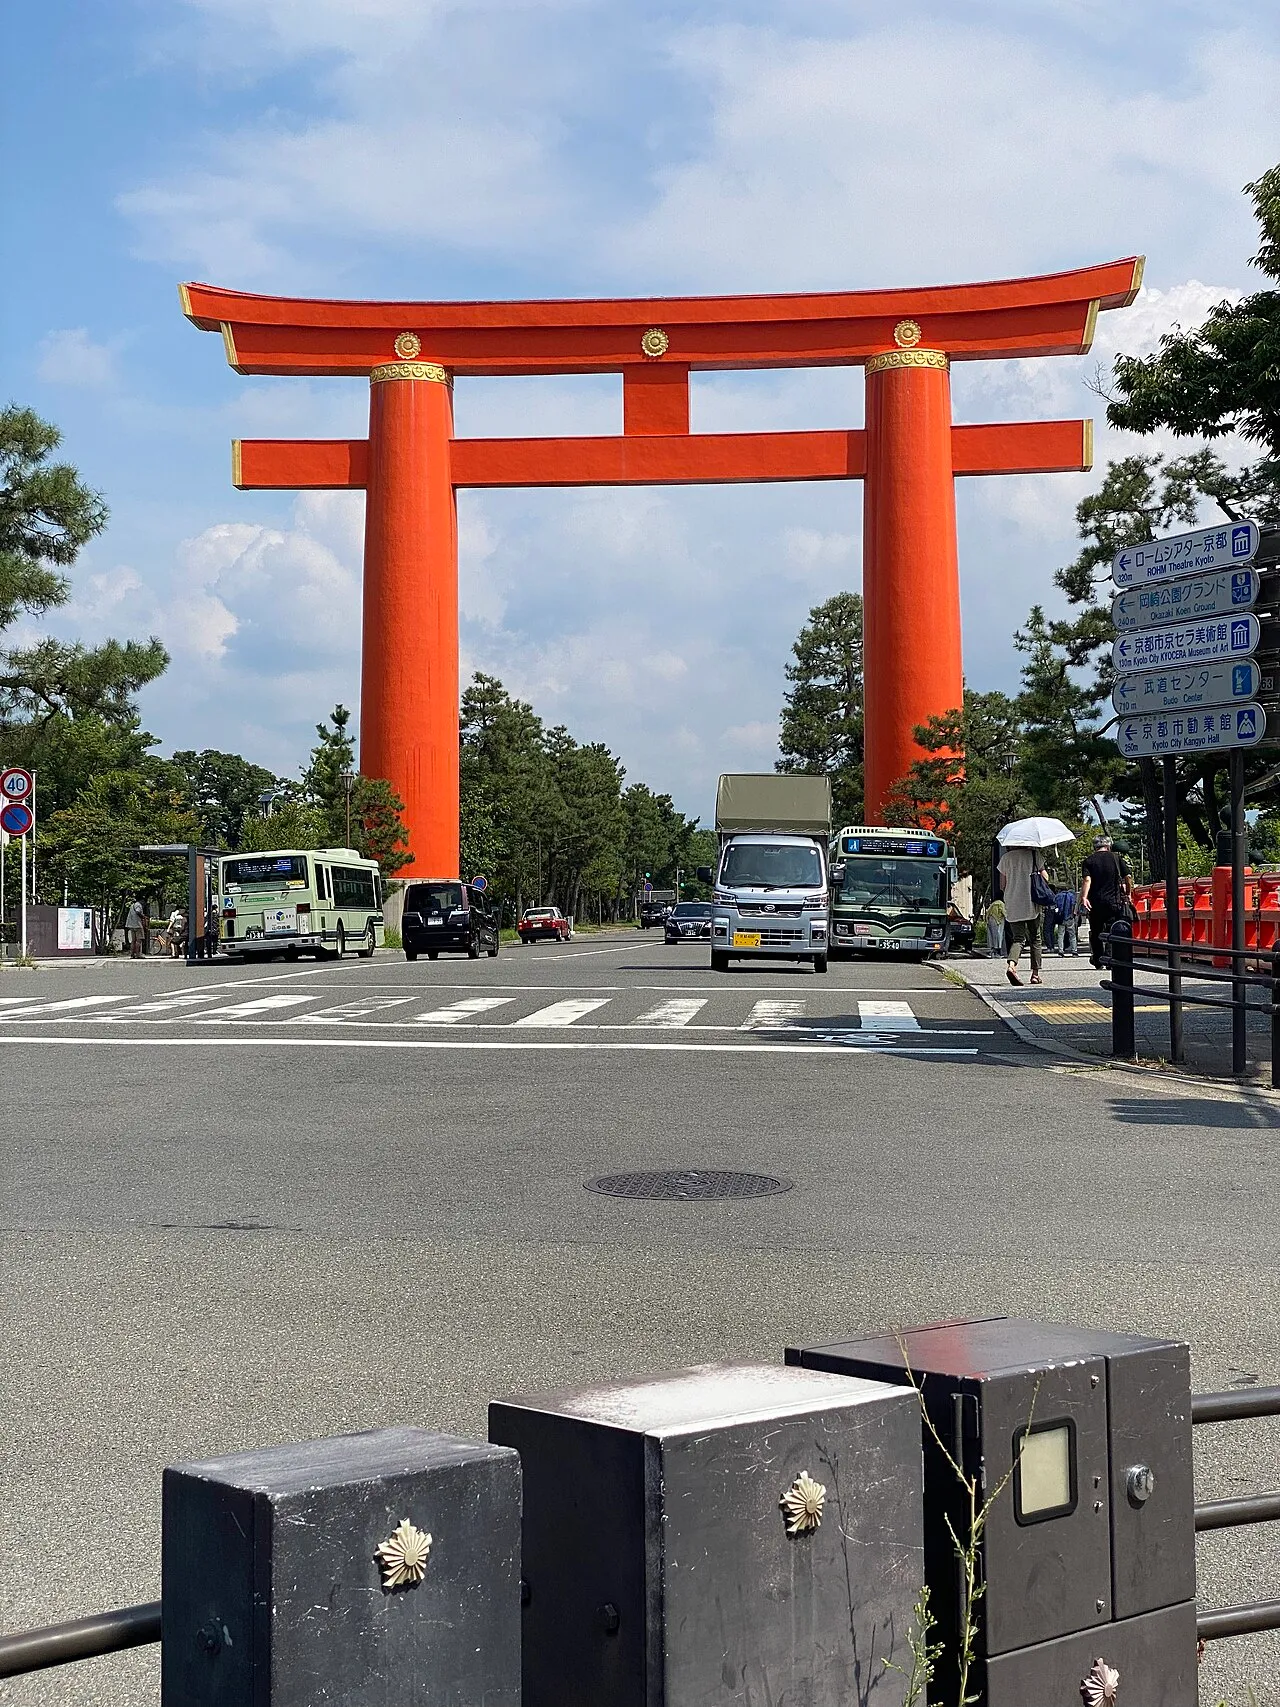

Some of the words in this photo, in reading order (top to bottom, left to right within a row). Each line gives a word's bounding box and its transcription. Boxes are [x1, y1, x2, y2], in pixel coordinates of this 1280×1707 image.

[1135, 531, 1228, 567] ロームシアター京都
[1147, 566, 1167, 577] ROHM
[1168, 560, 1194, 572] Theatre
[1195, 554, 1215, 568] Kyoto
[1118, 573, 1133, 583] 320m
[1140, 577, 1226, 609] 岡崎公園グランド
[1150, 607, 1174, 620] Okazaki
[1175, 606, 1192, 618] Koen
[1193, 601, 1216, 613] Ground
[1118, 617, 1136, 627] 240m
[1134, 623, 1228, 655] 京都市京セラ美術館
[1119, 658, 1132, 668] 130m
[1133, 656, 1148, 668] Kyoto
[1149, 653, 1160, 666] City
[1160, 650, 1187, 661] KYOCERA
[1188, 647, 1211, 658] Museum
[1212, 645, 1219, 654] of
[1219, 643, 1229, 653] Art
[1143, 671, 1224, 695] 武道センター
[1163, 695, 1178, 706] Budo
[1183, 693, 1203, 703] Center
[1142, 712, 1232, 740] 京都市勧業館
[1124, 743, 1139, 752] 250m
[1152, 740, 1169, 751] Kyoto
[1170, 738, 1182, 749] City
[1183, 735, 1206, 747] Kangyo
[1207, 734, 1220, 744] Hall
[7, 777, 25, 791] 40
